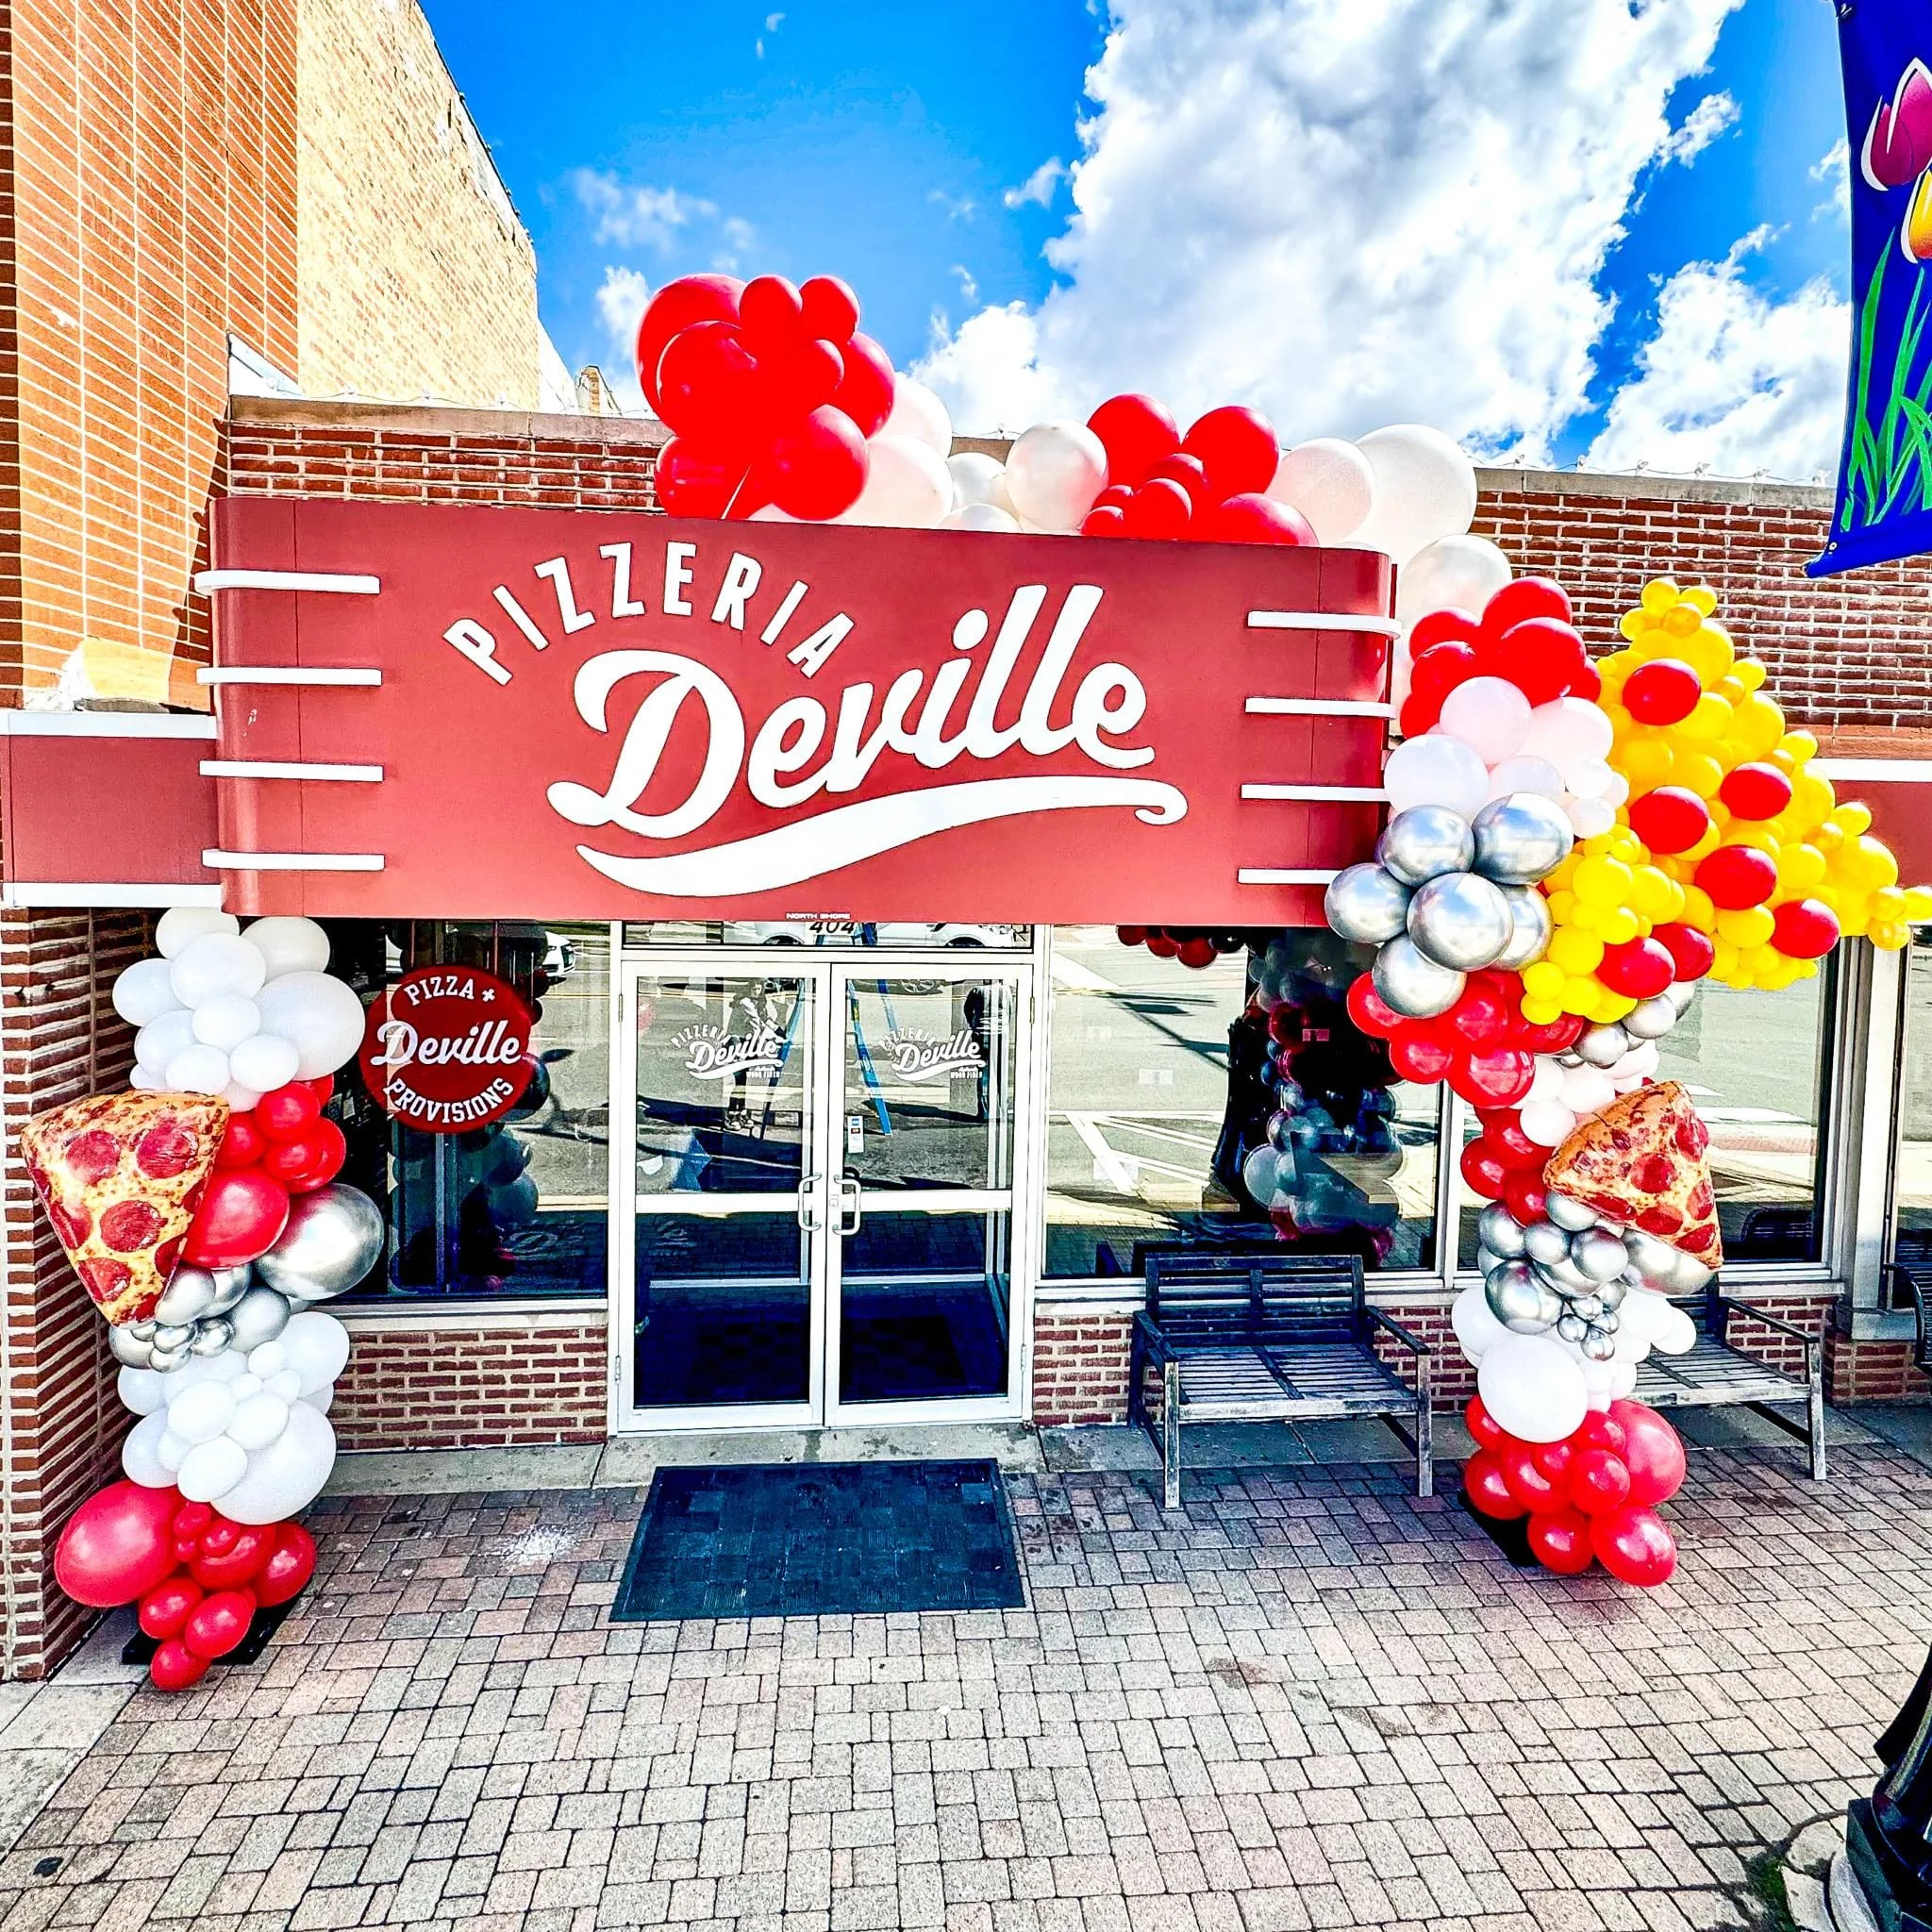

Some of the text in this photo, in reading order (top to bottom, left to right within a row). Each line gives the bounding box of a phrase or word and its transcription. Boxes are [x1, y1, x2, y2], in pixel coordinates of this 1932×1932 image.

[443, 541, 855, 686] PIZZERIA
[546, 584, 1156, 840] Deville
[808, 921, 856, 934] 404
[404, 975, 475, 1007] PIZZA
[371, 1020, 523, 1066] Deville
[671, 1024, 732, 1048] PIZZERIA
[685, 1028, 778, 1072] Deville
[877, 1026, 937, 1052] PIZZERIA
[891, 1029, 982, 1073] Deville
[383, 1077, 514, 1124] PROVISIONS
